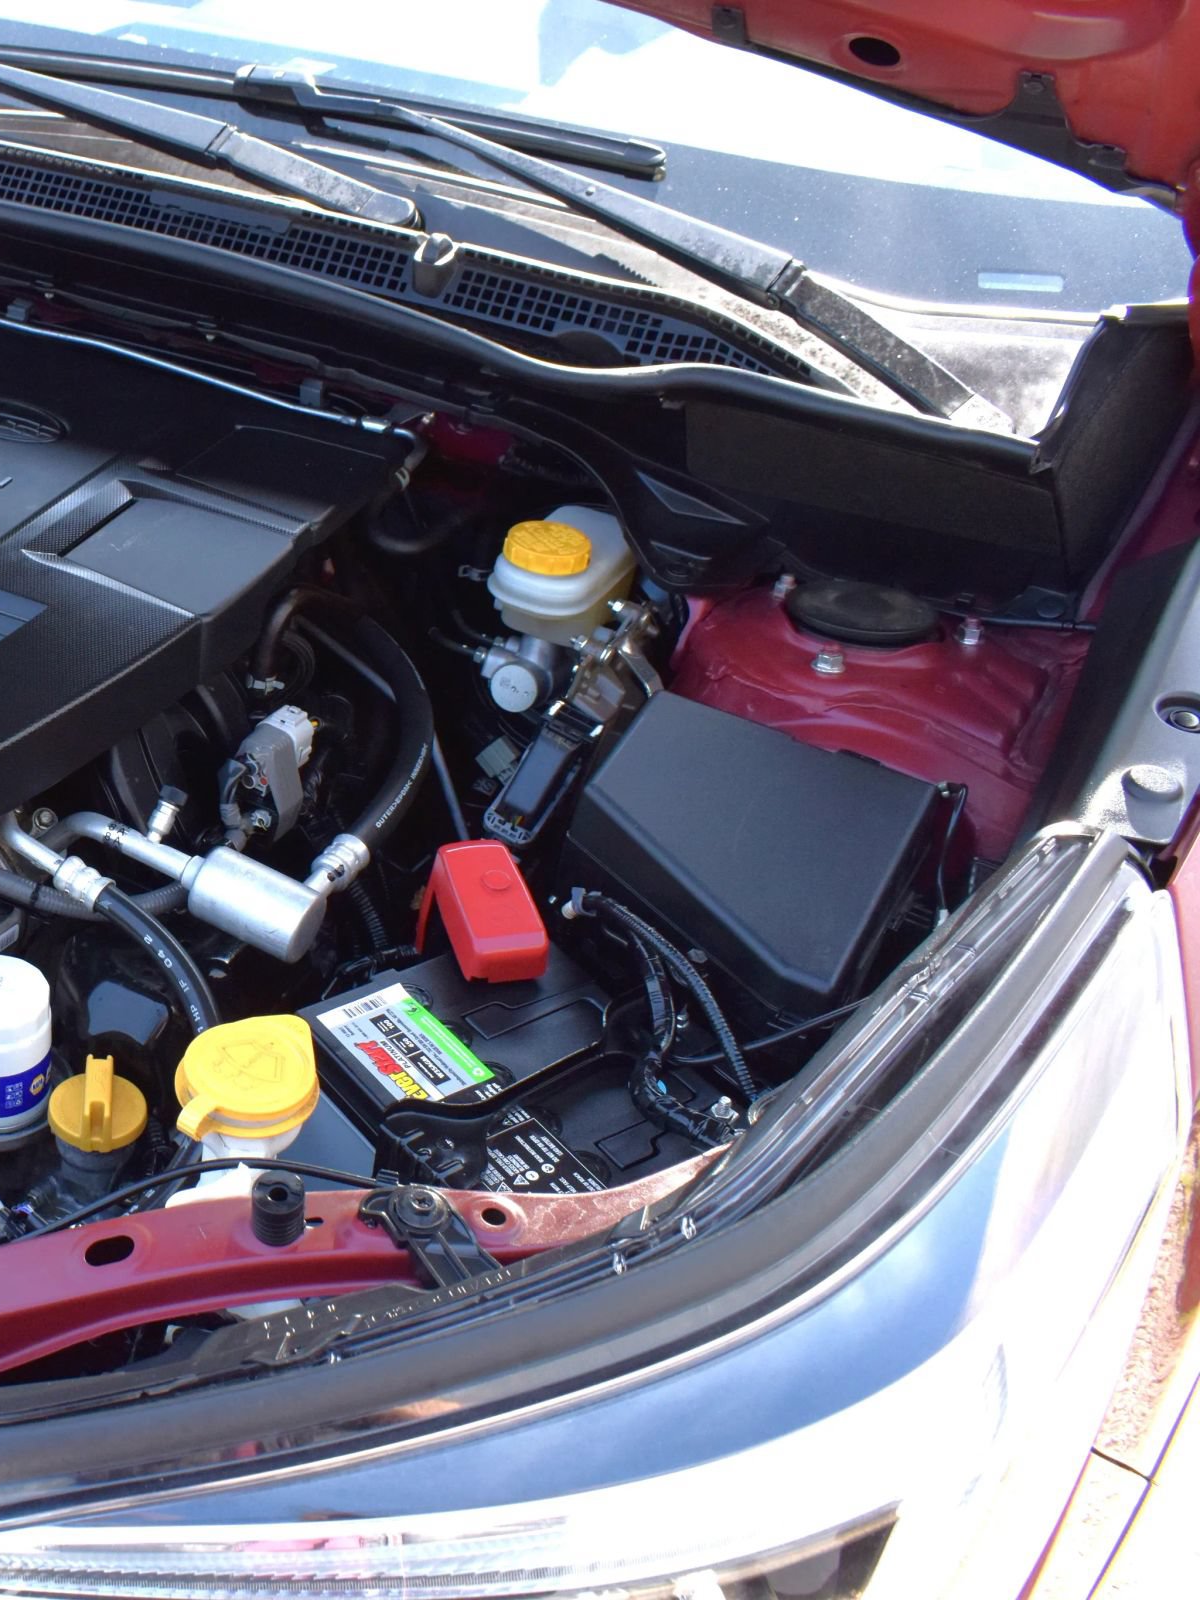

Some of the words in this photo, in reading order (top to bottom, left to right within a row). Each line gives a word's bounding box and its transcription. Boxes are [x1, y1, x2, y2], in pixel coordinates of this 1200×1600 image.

[384, 1019, 396, 1030] 100
[402, 1037, 415, 1049] 650
[380, 1040, 412, 1069] PLATINUM
